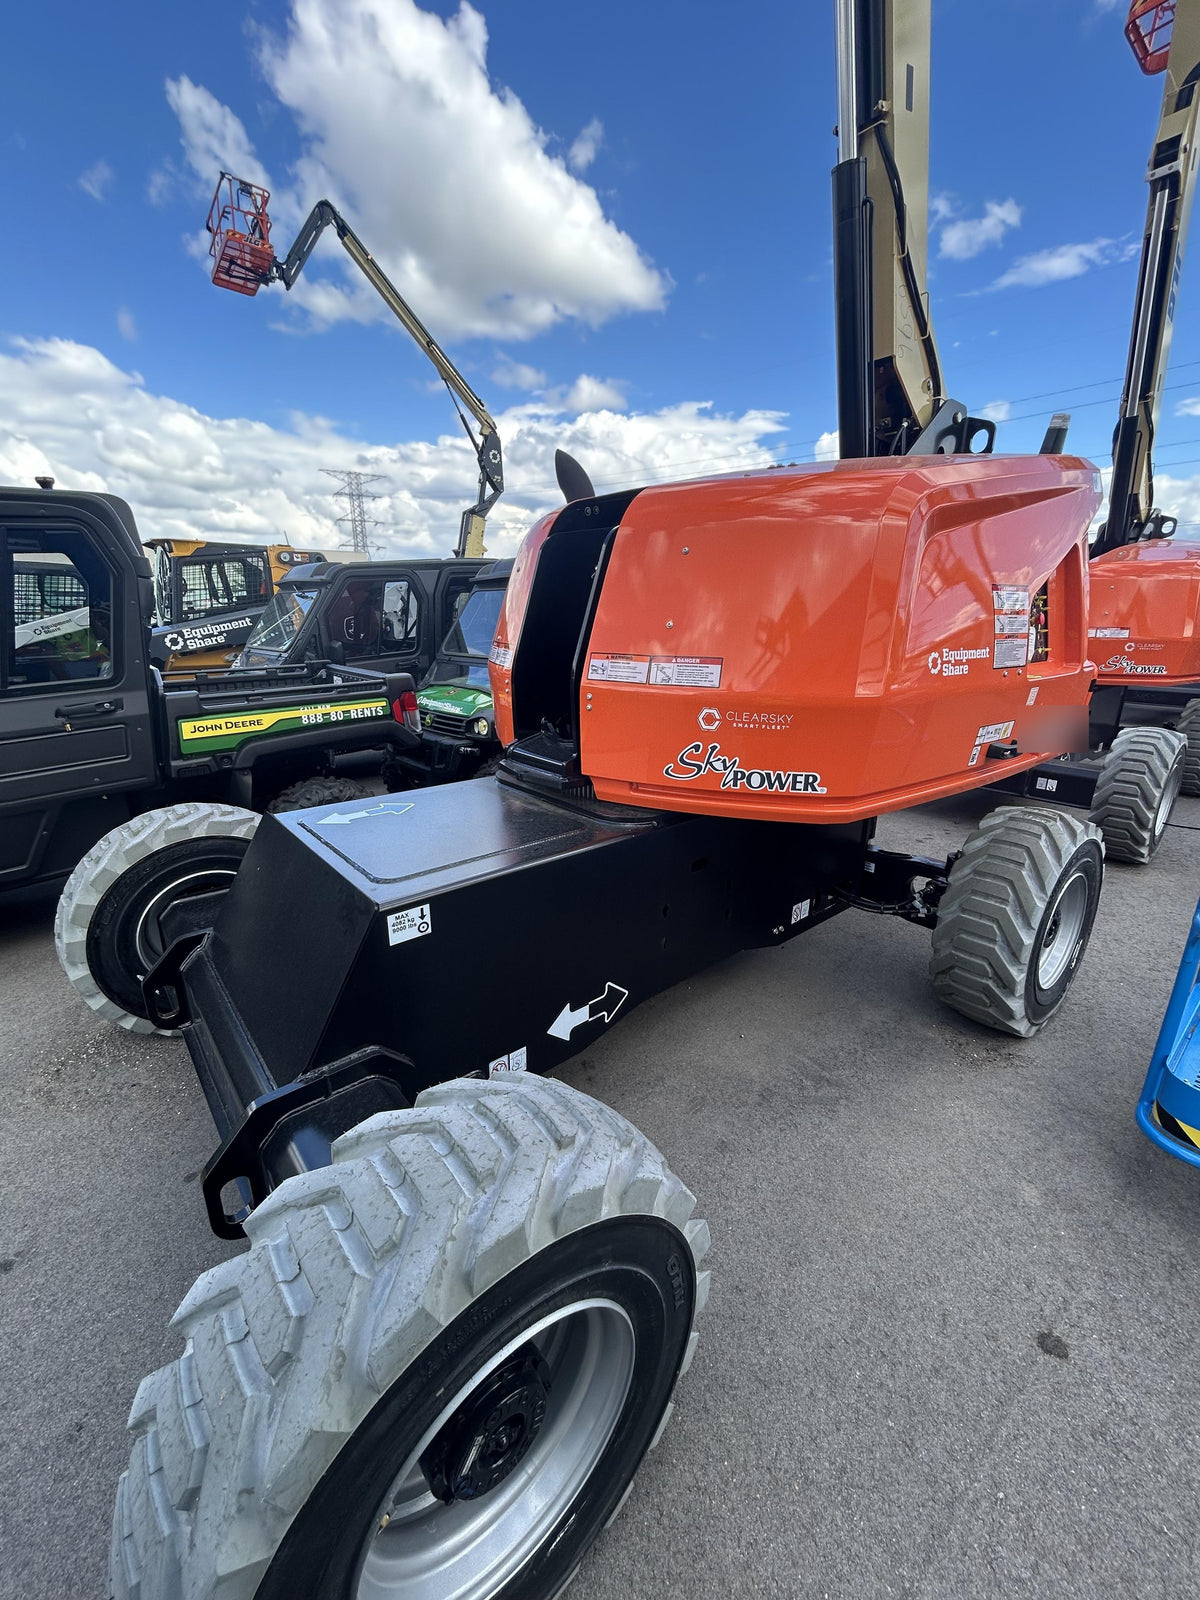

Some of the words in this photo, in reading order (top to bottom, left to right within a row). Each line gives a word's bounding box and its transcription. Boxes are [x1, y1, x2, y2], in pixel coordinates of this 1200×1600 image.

[182, 617, 253, 638] Equipment
[186, 634, 227, 650] Share
[942, 646, 990, 663] Equipment
[942, 663, 969, 676] Share
[301, 706, 384, 725] 888-80-RENTS
[725, 710, 794, 724] CLEARSKY
[190, 724, 223, 734] JOHN
[225, 719, 264, 729] DEERE
[395, 912, 409, 920] MAX
